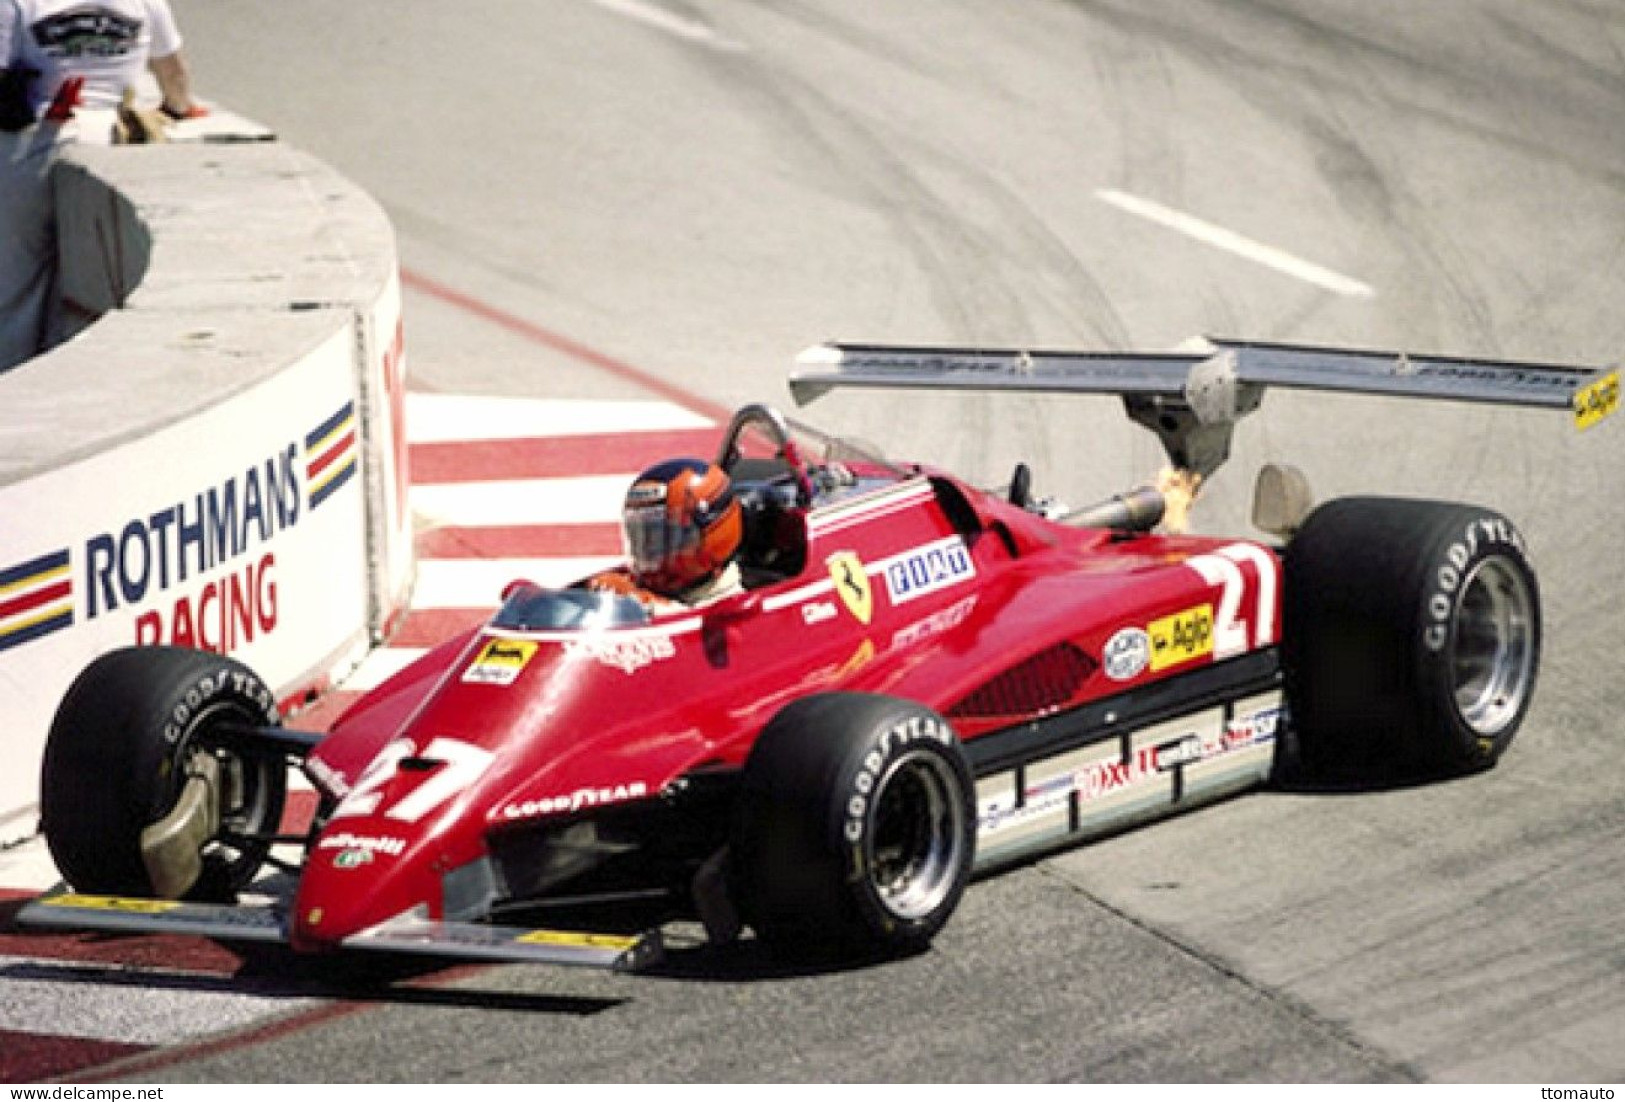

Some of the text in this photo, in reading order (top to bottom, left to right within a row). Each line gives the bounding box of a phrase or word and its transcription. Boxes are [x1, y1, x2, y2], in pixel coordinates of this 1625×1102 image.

[84, 441, 300, 620] ROTHMANS
[1173, 611, 1209, 655] Agip
[1183, 542, 1276, 663] 27
[330, 736, 498, 823] 27
[502, 781, 648, 819] GOODYEAR
[844, 716, 951, 842] GOODYEAR
